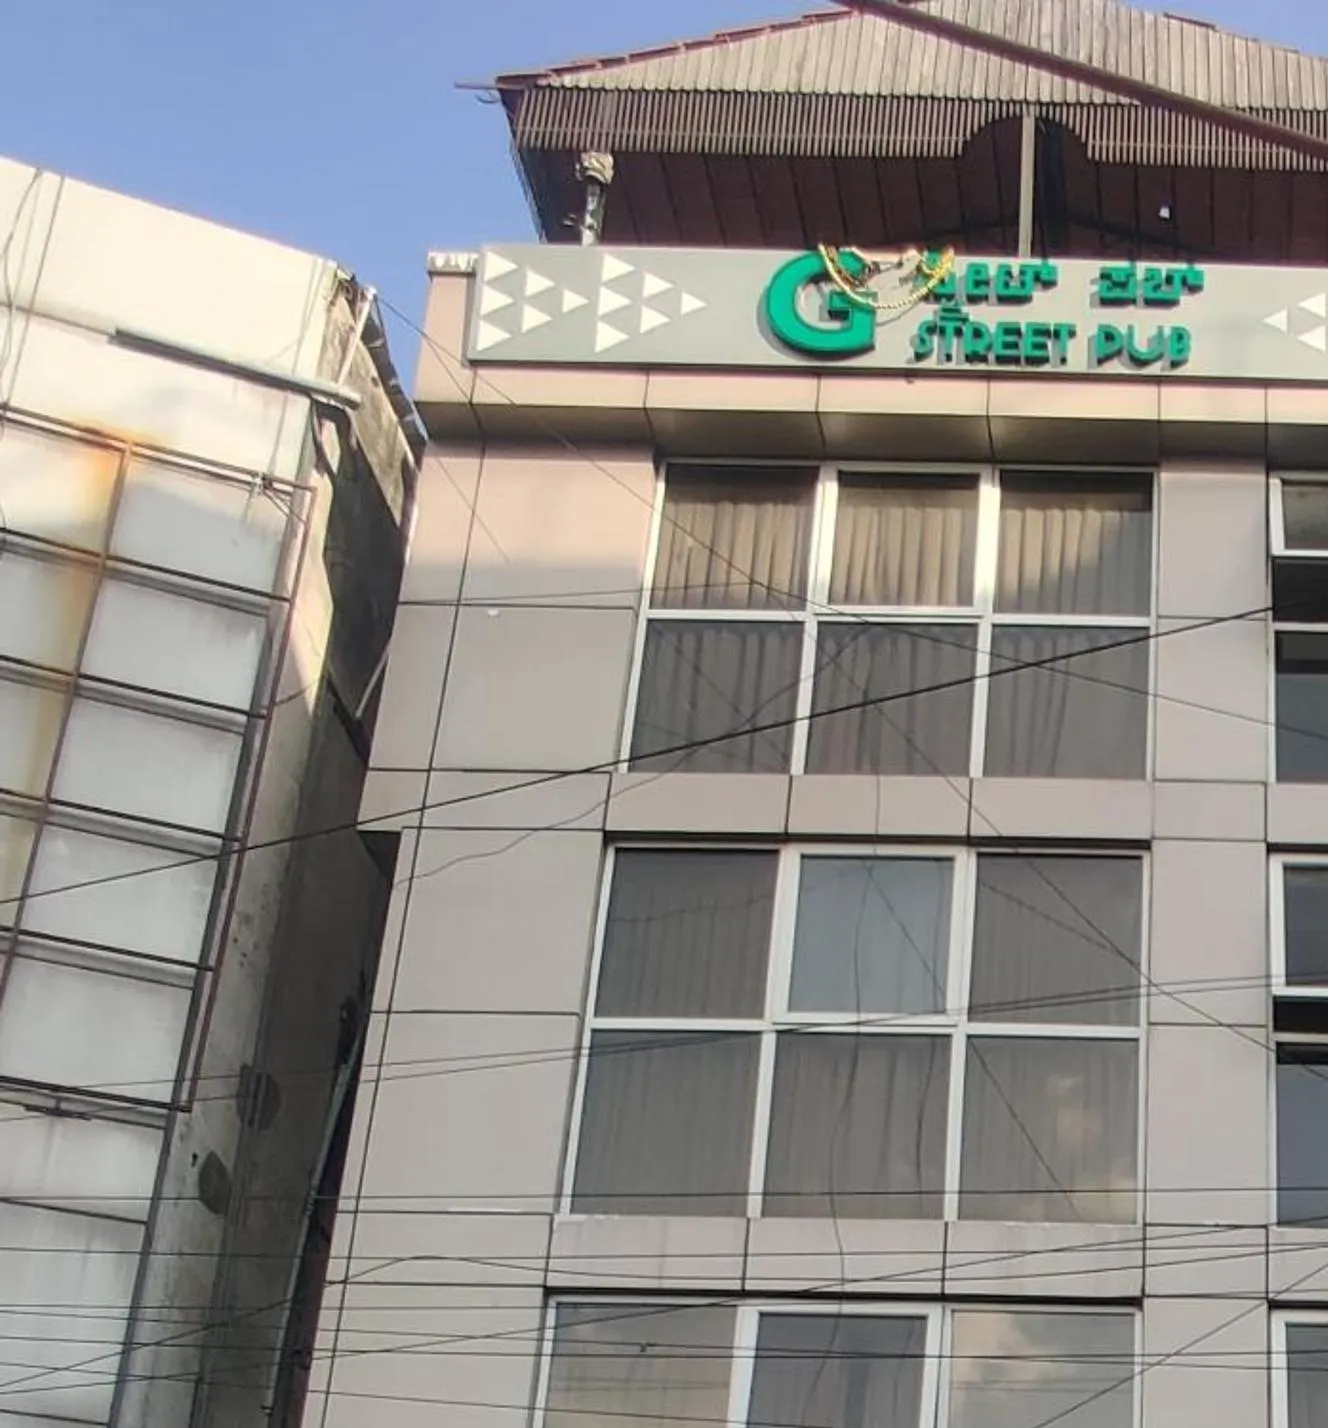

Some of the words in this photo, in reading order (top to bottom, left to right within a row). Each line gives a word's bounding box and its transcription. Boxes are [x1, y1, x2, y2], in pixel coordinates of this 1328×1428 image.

[762, 250, 877, 355] G
[1097, 260, 1207, 303] ಪಬ್
[912, 317, 1077, 362] STREET
[1094, 324, 1192, 368] PUB
